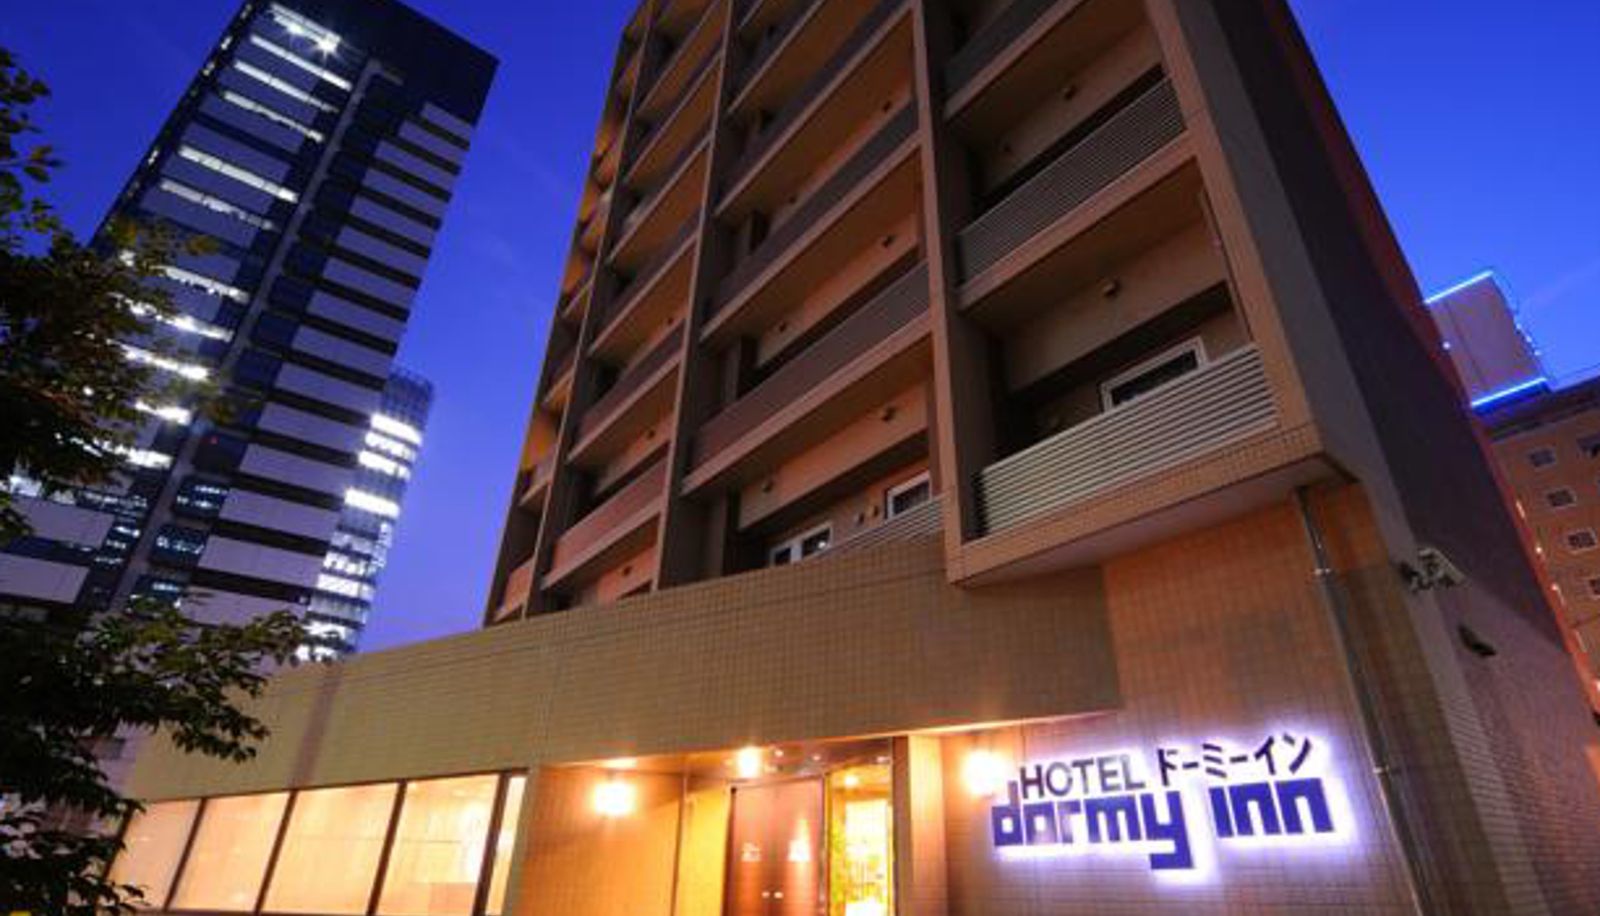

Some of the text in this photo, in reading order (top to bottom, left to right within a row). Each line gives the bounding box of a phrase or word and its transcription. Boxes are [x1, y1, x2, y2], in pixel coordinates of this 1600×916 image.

[1020, 753, 1146, 799] HOTEL
[1157, 732, 1313, 787] ドーミーイン
[991, 777, 1335, 870] dormy inn
